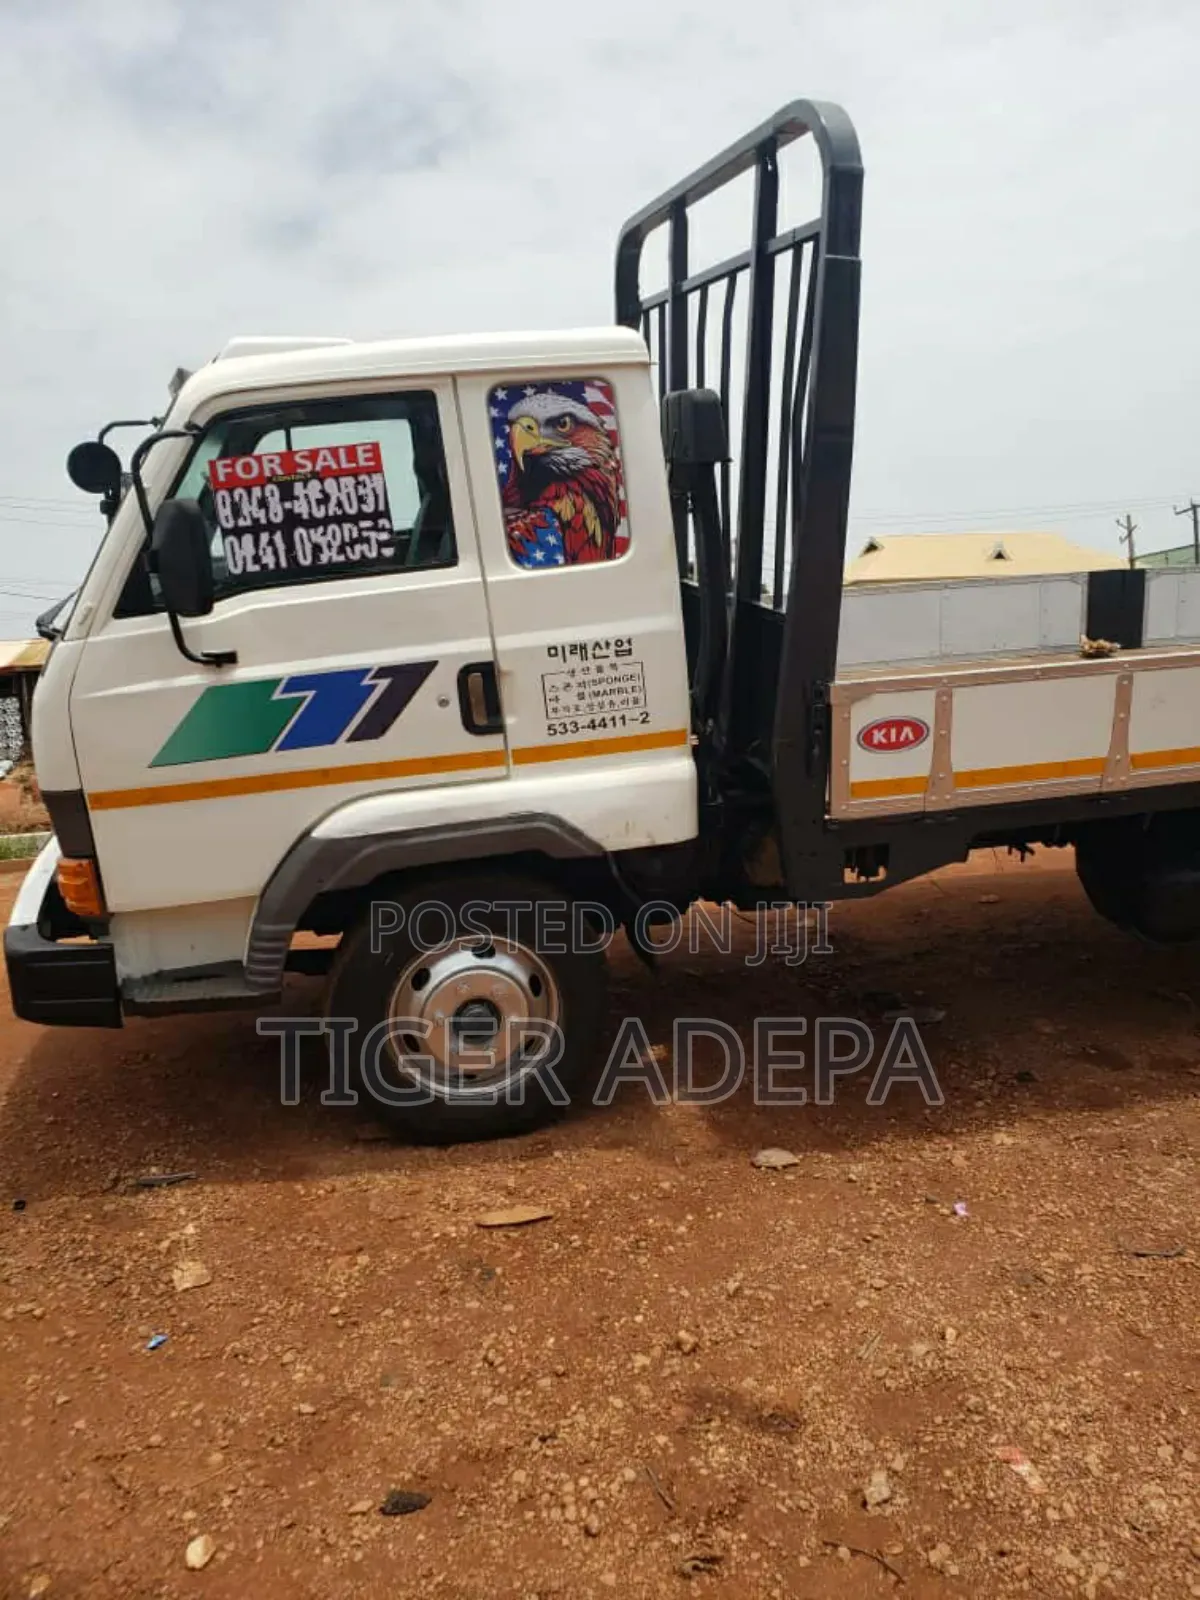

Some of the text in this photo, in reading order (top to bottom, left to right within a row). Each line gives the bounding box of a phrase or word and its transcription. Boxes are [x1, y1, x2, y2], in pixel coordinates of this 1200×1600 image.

[215, 444, 376, 482] FOR SALE
[547, 637, 632, 663] 미래산업
[871, 725, 915, 745] KIA
